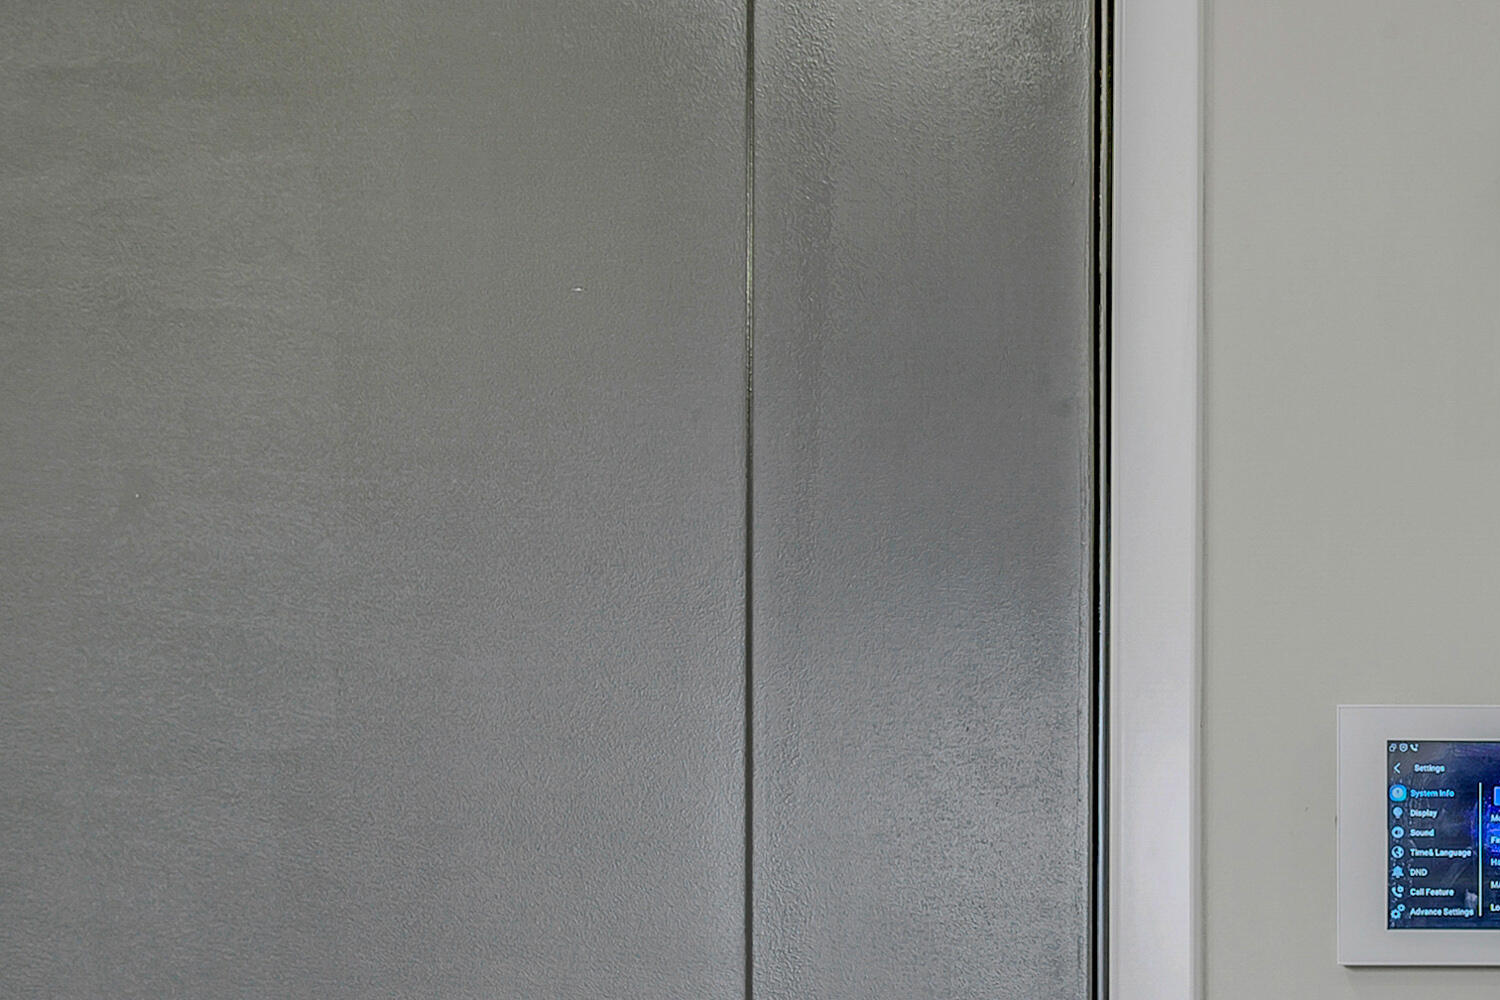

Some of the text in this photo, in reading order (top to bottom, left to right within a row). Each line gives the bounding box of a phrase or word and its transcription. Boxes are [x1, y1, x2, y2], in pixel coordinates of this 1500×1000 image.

[1414, 764, 1445, 774] Settings
[1410, 789, 1455, 799] System Info
[1410, 809, 1438, 819] Display
[1410, 828, 1435, 837] Sound
[1435, 848, 1472, 858] Language
[1410, 868, 1428, 876] DND
[1410, 888, 1455, 897] Call Feature
[1410, 907, 1475, 918] Advance Settings
